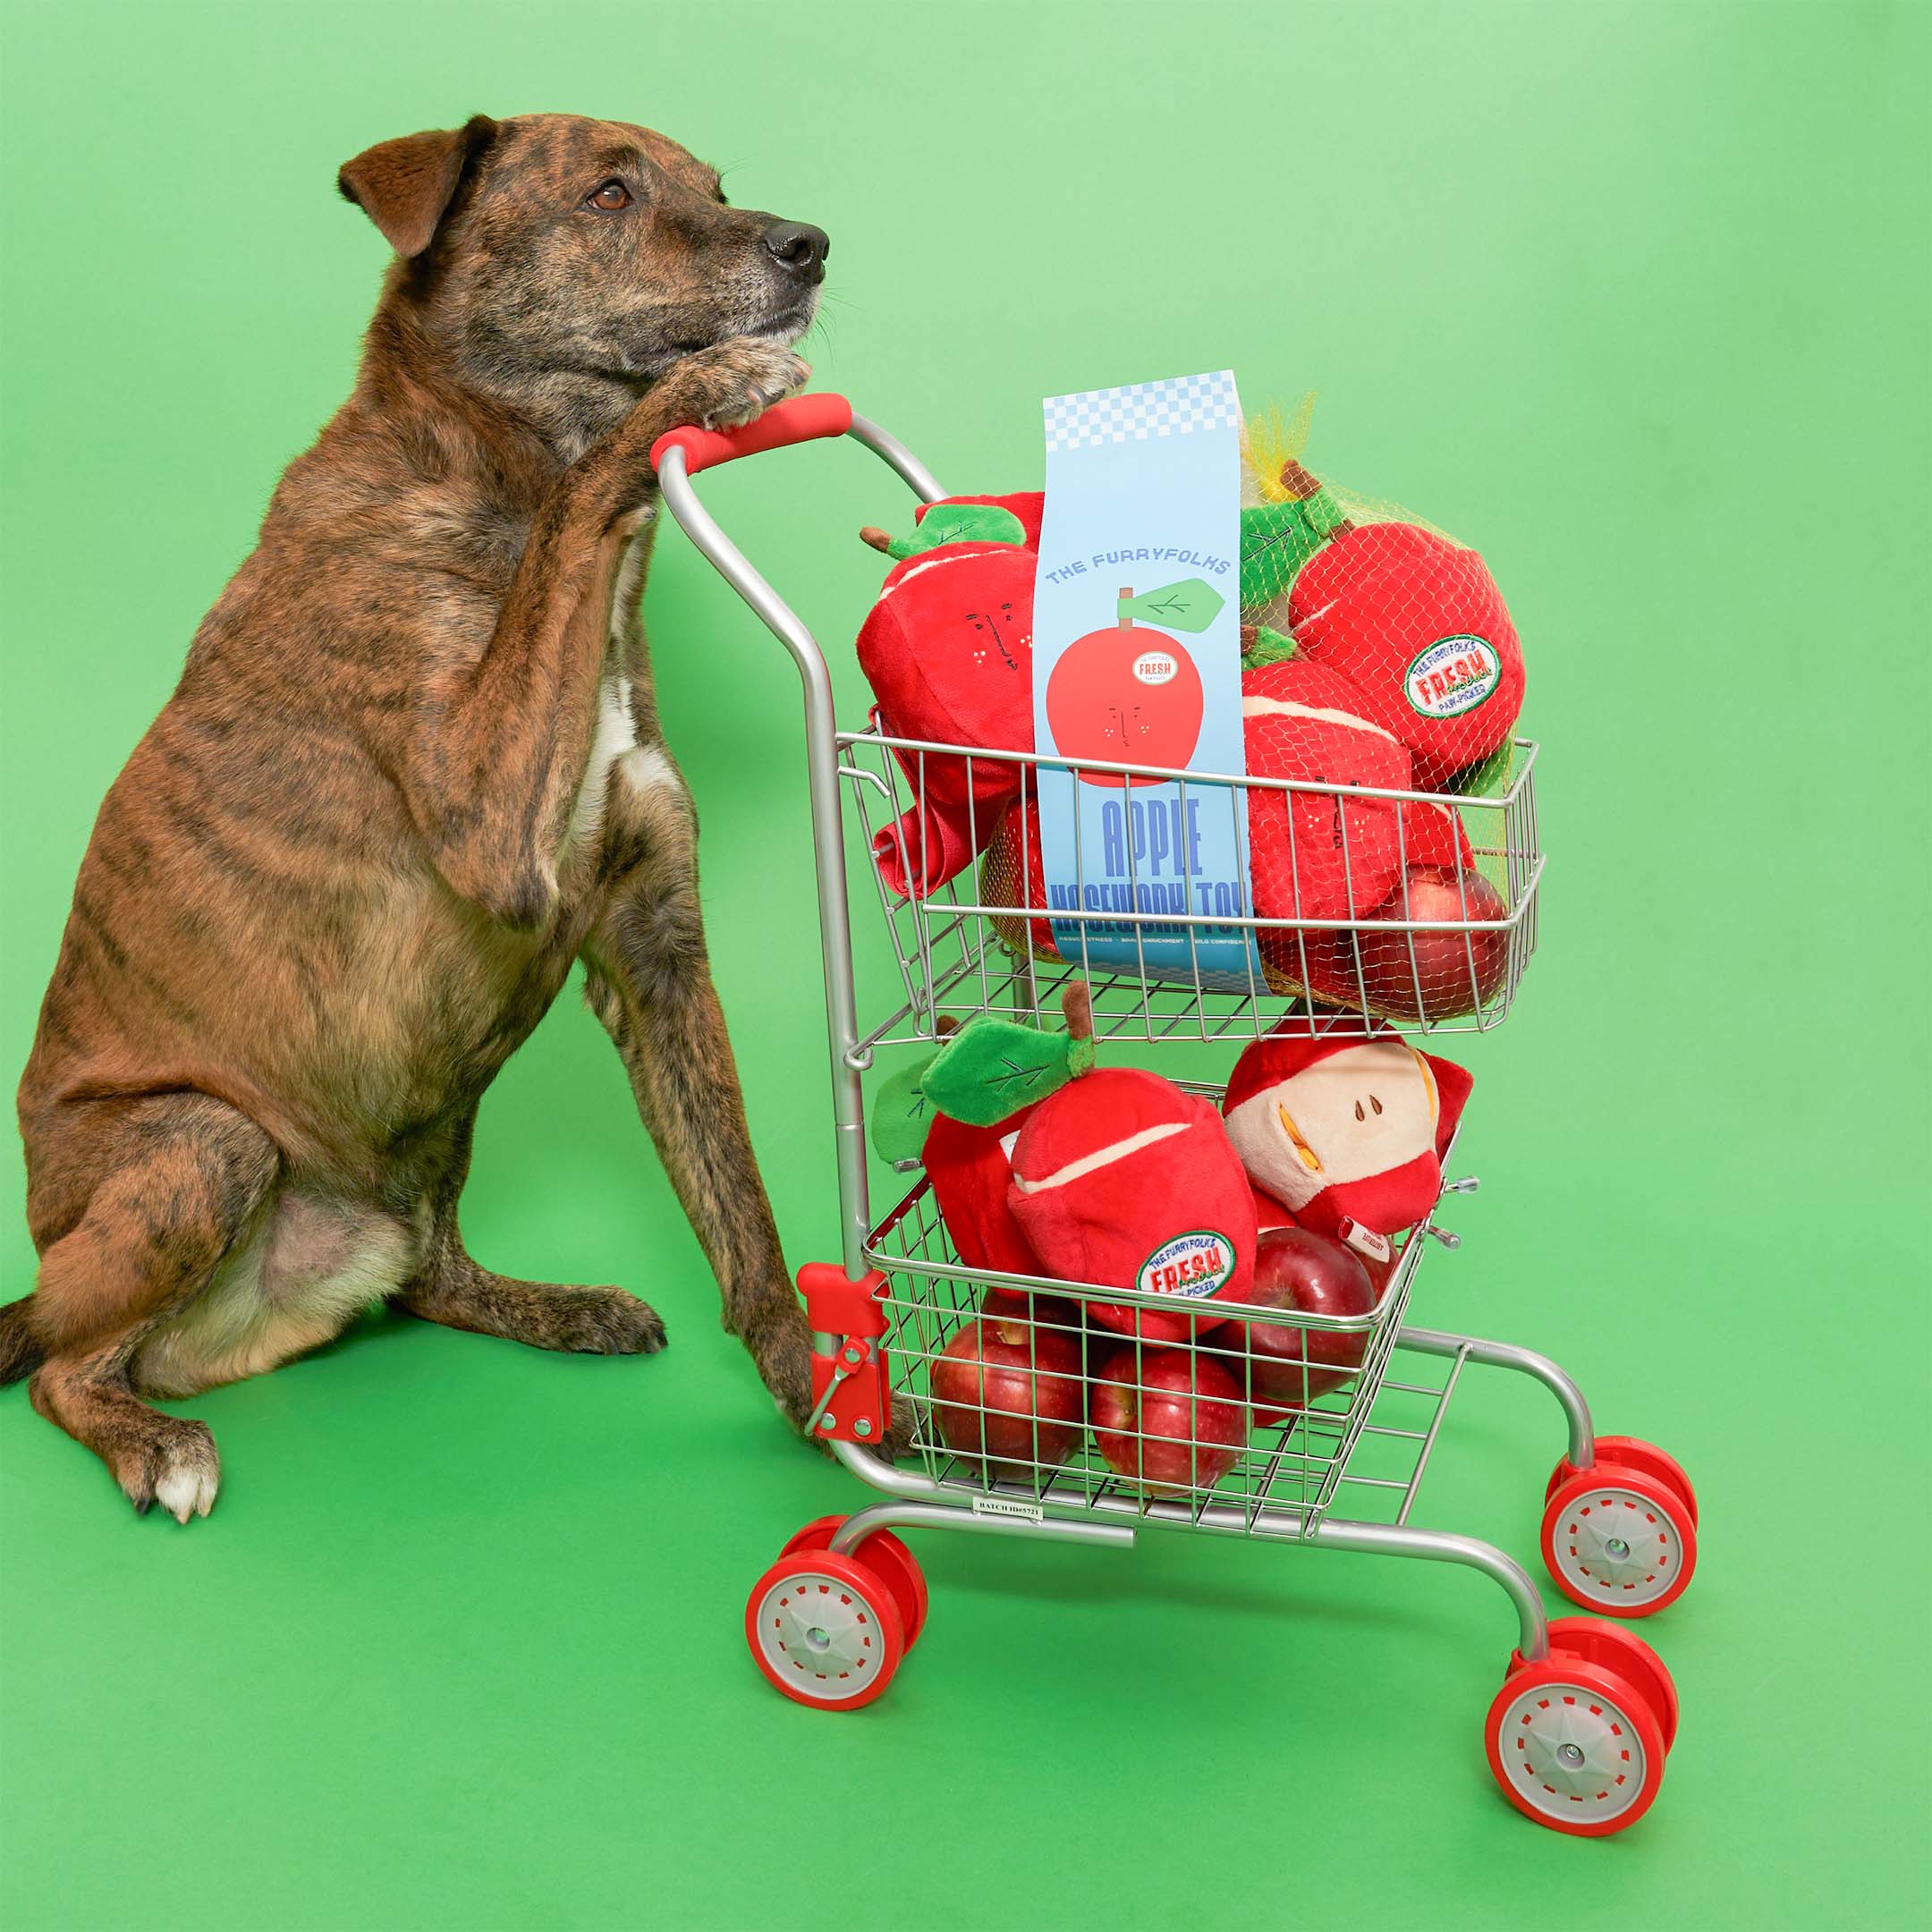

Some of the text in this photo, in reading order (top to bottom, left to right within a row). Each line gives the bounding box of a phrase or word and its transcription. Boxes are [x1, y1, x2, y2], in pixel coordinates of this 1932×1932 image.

[1045, 547, 1232, 585] THE FURRYFOLKS
[1139, 662, 1172, 675] FRESH
[1413, 662, 1432, 678] THE
[1415, 648, 1491, 707] FRESH
[1101, 799, 1203, 877] APPLE
[1049, 881, 1191, 934] NOSEWORK
[1148, 1253, 1166, 1270] THE
[1149, 1246, 1224, 1293] FRESH
[980, 1502, 1007, 1512] BATCH
